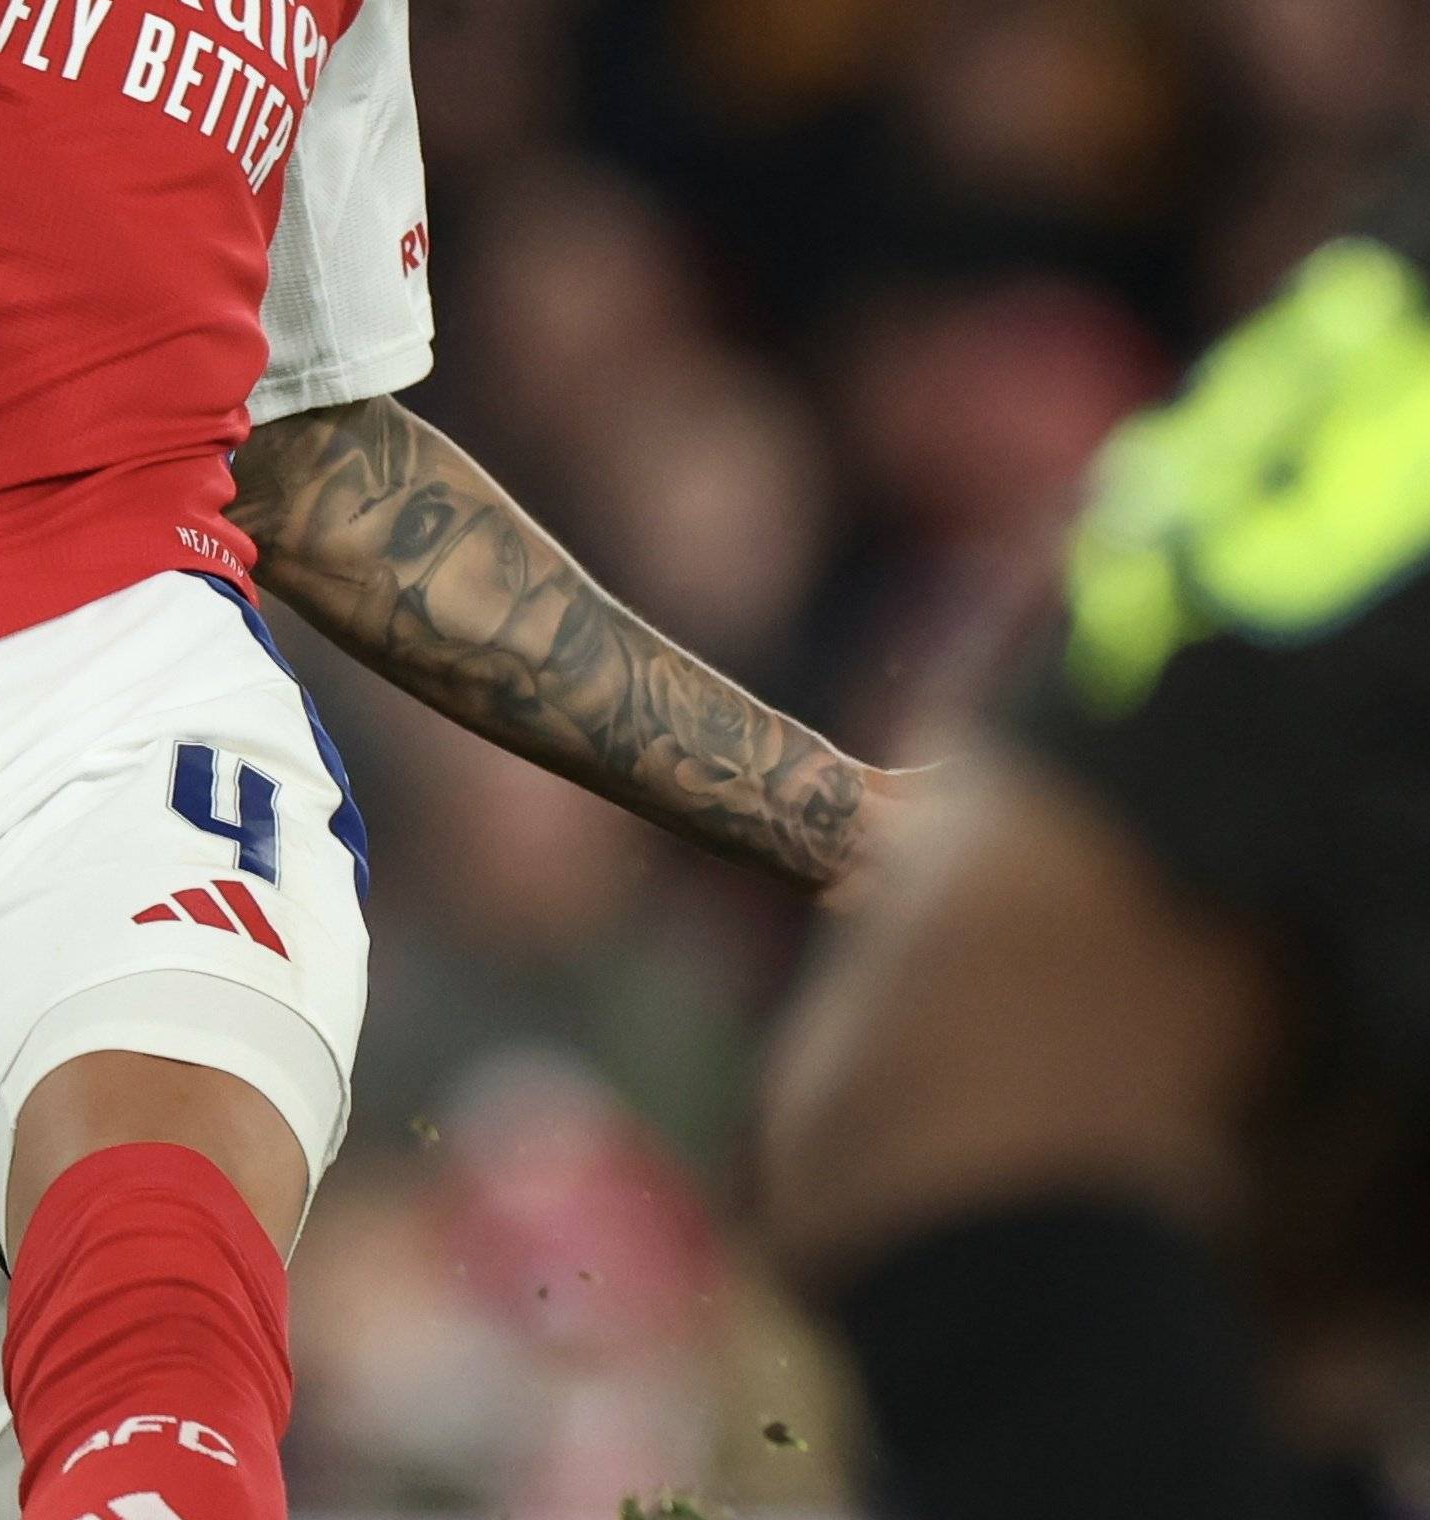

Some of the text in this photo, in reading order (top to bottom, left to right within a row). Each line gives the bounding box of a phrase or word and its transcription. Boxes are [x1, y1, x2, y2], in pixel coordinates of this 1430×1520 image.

[121, 12, 295, 196] BETTER
[175, 526, 220, 560] HEAT
[168, 740, 282, 890] 4
[62, 1414, 238, 1474] AFC
